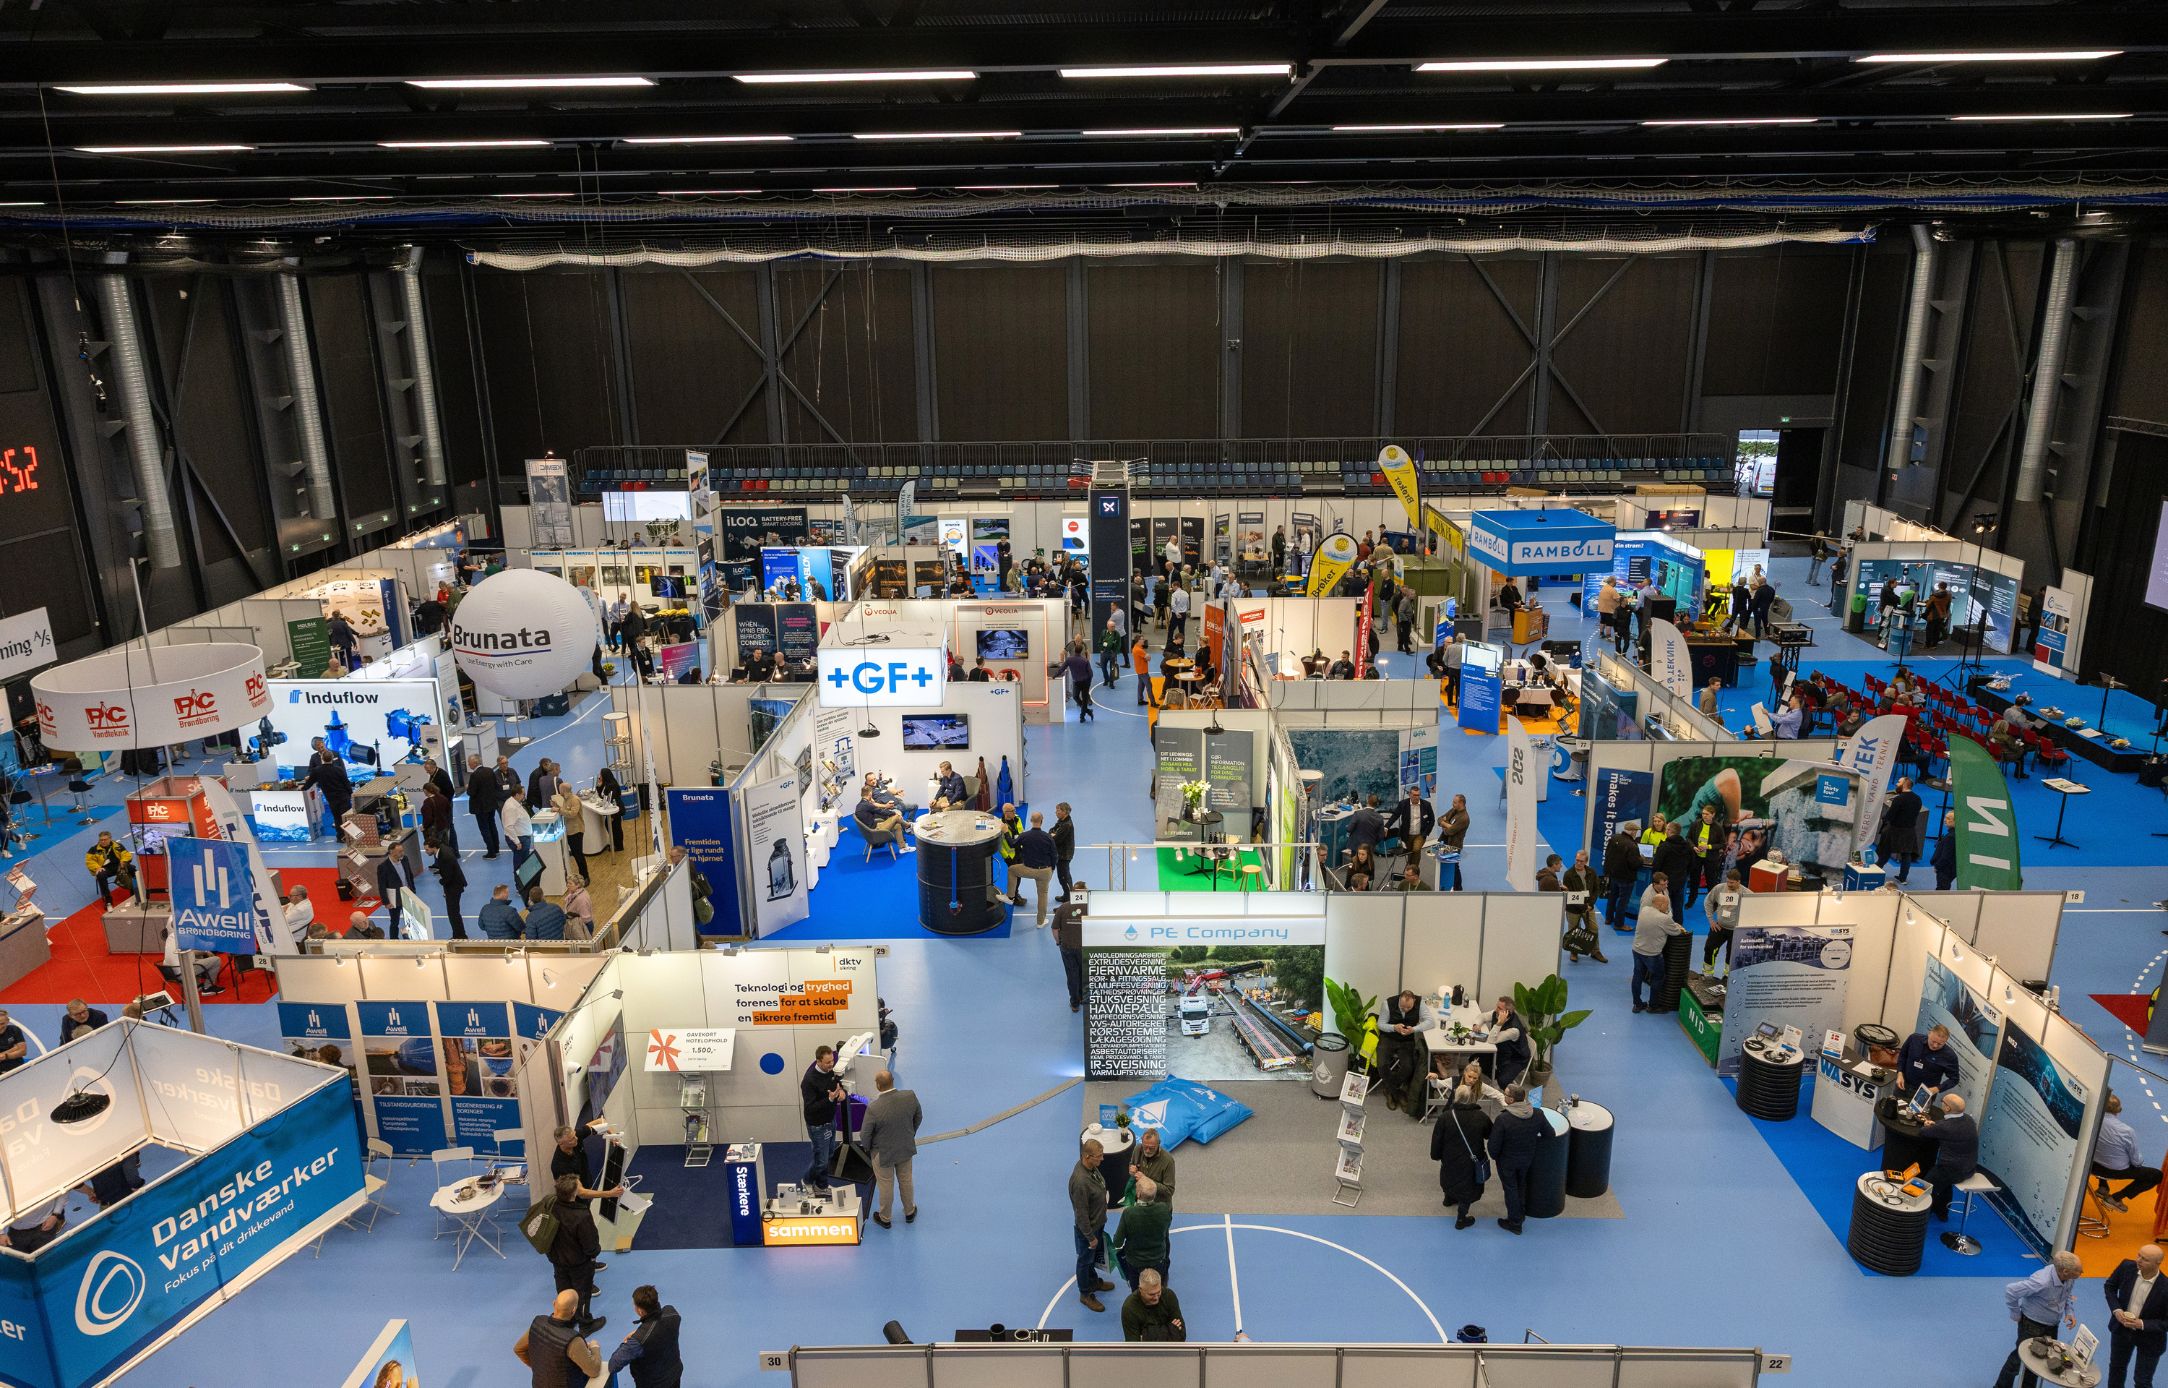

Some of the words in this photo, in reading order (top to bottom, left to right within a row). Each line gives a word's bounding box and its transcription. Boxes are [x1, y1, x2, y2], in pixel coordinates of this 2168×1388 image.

[1473, 531, 1505, 557] RAMBØLL
[1521, 541, 1605, 559] RAMBØLL
[453, 624, 552, 650] Brunata
[497, 659, 513, 668] with
[514, 658, 533, 666] Care
[305, 691, 379, 704] Induflow
[179, 713, 220, 729] Brøndboring
[92, 728, 130, 739] Vandteknik
[1608, 773, 1620, 808] makes
[682, 794, 714, 802] Brunata
[263, 804, 305, 813] Induflow
[684, 838, 721, 846] Fremtiden
[691, 847, 706, 856] lige
[705, 847, 724, 855] rundt
[698, 855, 724, 864] hjørnet
[178, 908, 250, 930] Awell
[178, 927, 251, 939] BRØNDBORING
[1151, 926, 1179, 939] PE
[1187, 926, 1289, 940] Company
[258, 957, 267, 965] 28
[839, 957, 862, 967] dktv
[1089, 966, 1167, 975] FJERNVARME
[734, 982, 788, 994] Teknologi
[790, 984, 804, 993] og
[805, 981, 850, 993] tryghed
[736, 998, 778, 1008] forenes
[780, 997, 796, 1007] for
[799, 998, 811, 1006] at
[813, 997, 847, 1006] skabe
[1089, 996, 1167, 1004] STUKSVEJSNING
[1089, 1004, 1167, 1014] HAVNEPÆLE
[737, 1015, 752, 1023] en
[753, 1013, 791, 1023] sikrere
[793, 1012, 835, 1022] fremtid
[306, 1027, 328, 1035] Awell
[385, 1025, 408, 1033] Awell
[464, 1026, 487, 1034] Awell
[1089, 1028, 1167, 1036] RØRSYSTEMER
[1090, 1060, 1167, 1069] IR-SVEJSNING
[1820, 1058, 1876, 1099] WASYS
[736, 1166, 750, 1217] Stærkere
[151, 1159, 273, 1249] Danske
[158, 1147, 339, 1272] Vandværker
[768, 1224, 853, 1238] sammen
[164, 1264, 200, 1294] Fokus
[202, 1251, 217, 1273] på
[219, 1240, 235, 1257] dit
[237, 1200, 295, 1244] drikkevand
[767, 1357, 782, 1367] 30
[1768, 1359, 1783, 1369] 22
